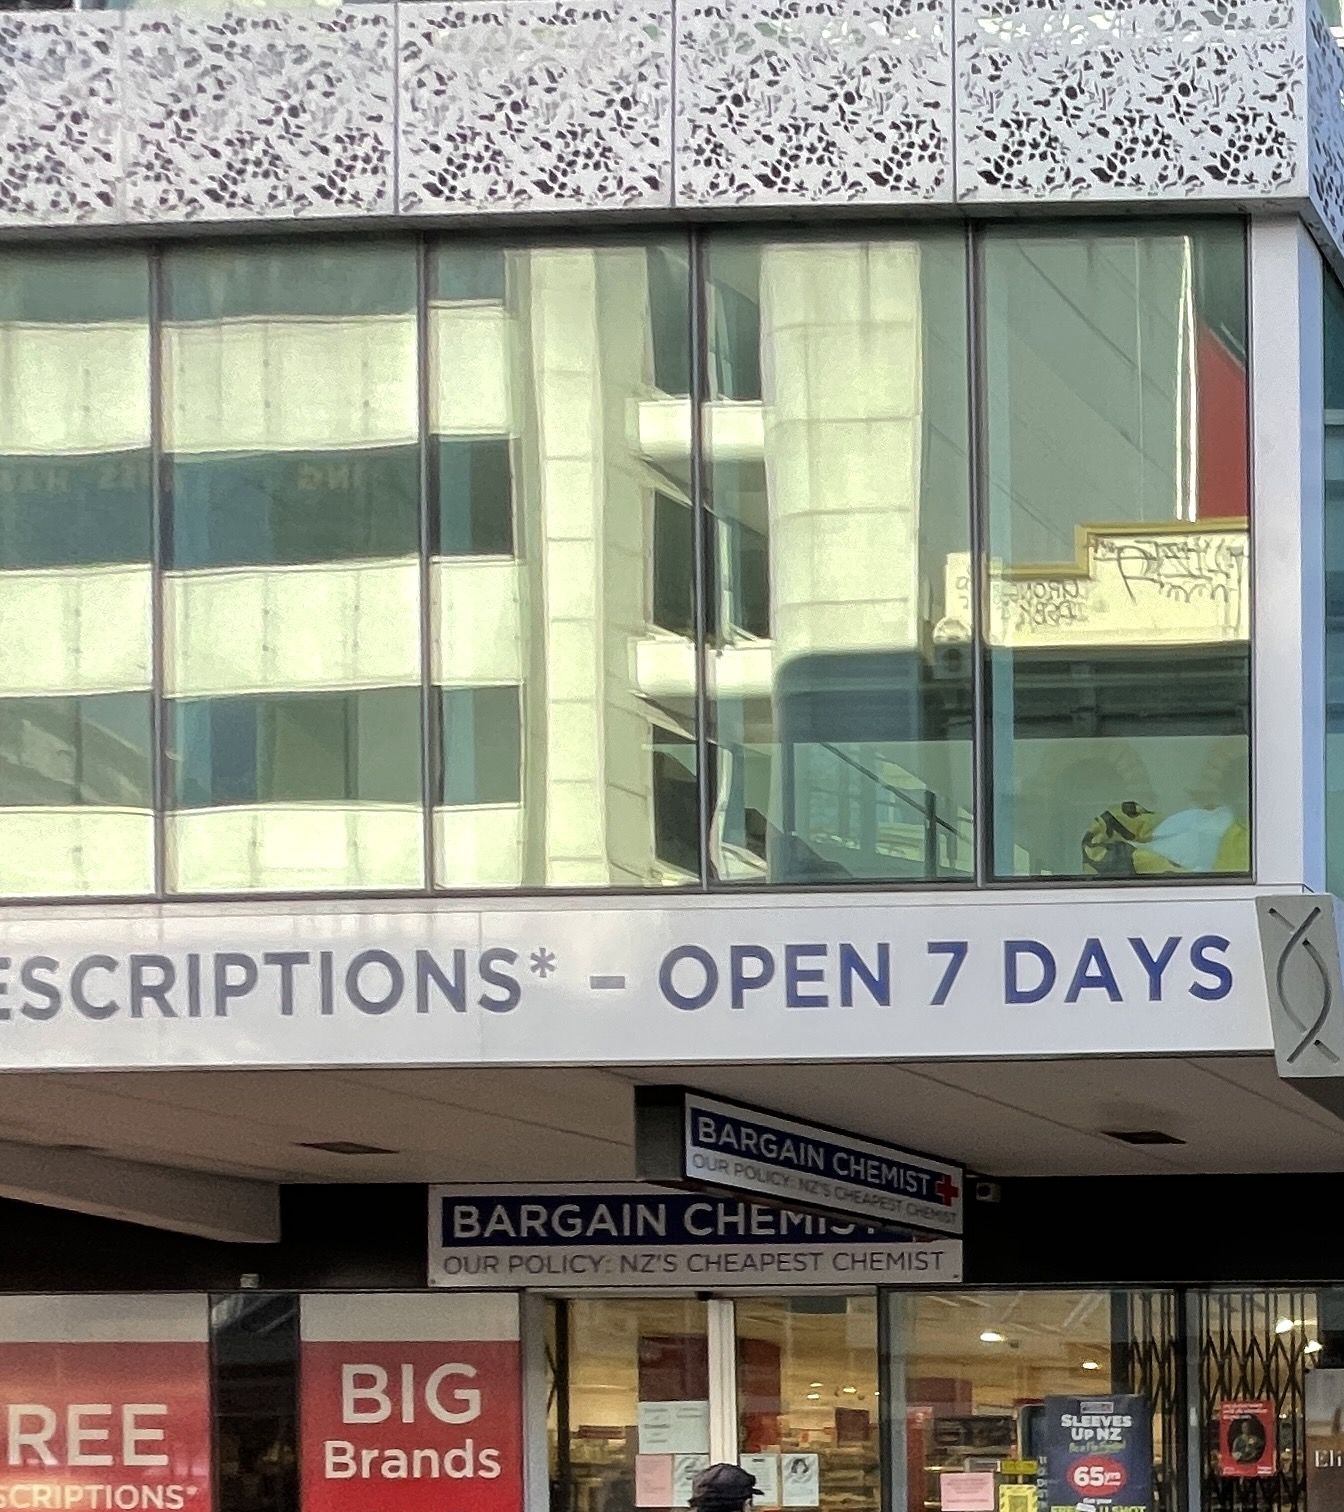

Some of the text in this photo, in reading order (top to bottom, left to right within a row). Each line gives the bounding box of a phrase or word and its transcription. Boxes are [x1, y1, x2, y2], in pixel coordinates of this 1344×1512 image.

[0, 947, 557, 1022] SCRIPTIONS
[659, 942, 892, 1011] OPEN
[927, 941, 969, 1005] 7
[1005, 935, 1234, 1003] DAYS
[692, 1152, 729, 1173] OUR
[698, 1116, 931, 1196] BARGAIN CHEMIST
[453, 1202, 877, 1238] BARGAIN CHEMI
[443, 1250, 945, 1275] OUR POLICY: NZ'S CHEAPEST CHEMIST
[342, 1362, 481, 1424] BIG
[8, 1403, 169, 1466] REE
[1061, 1413, 1132, 1428] SLEEVES
[1096, 1427, 1122, 1440] NZ
[324, 1438, 502, 1479] Brands
[0, 1484, 199, 1510] CRIPTIONS
